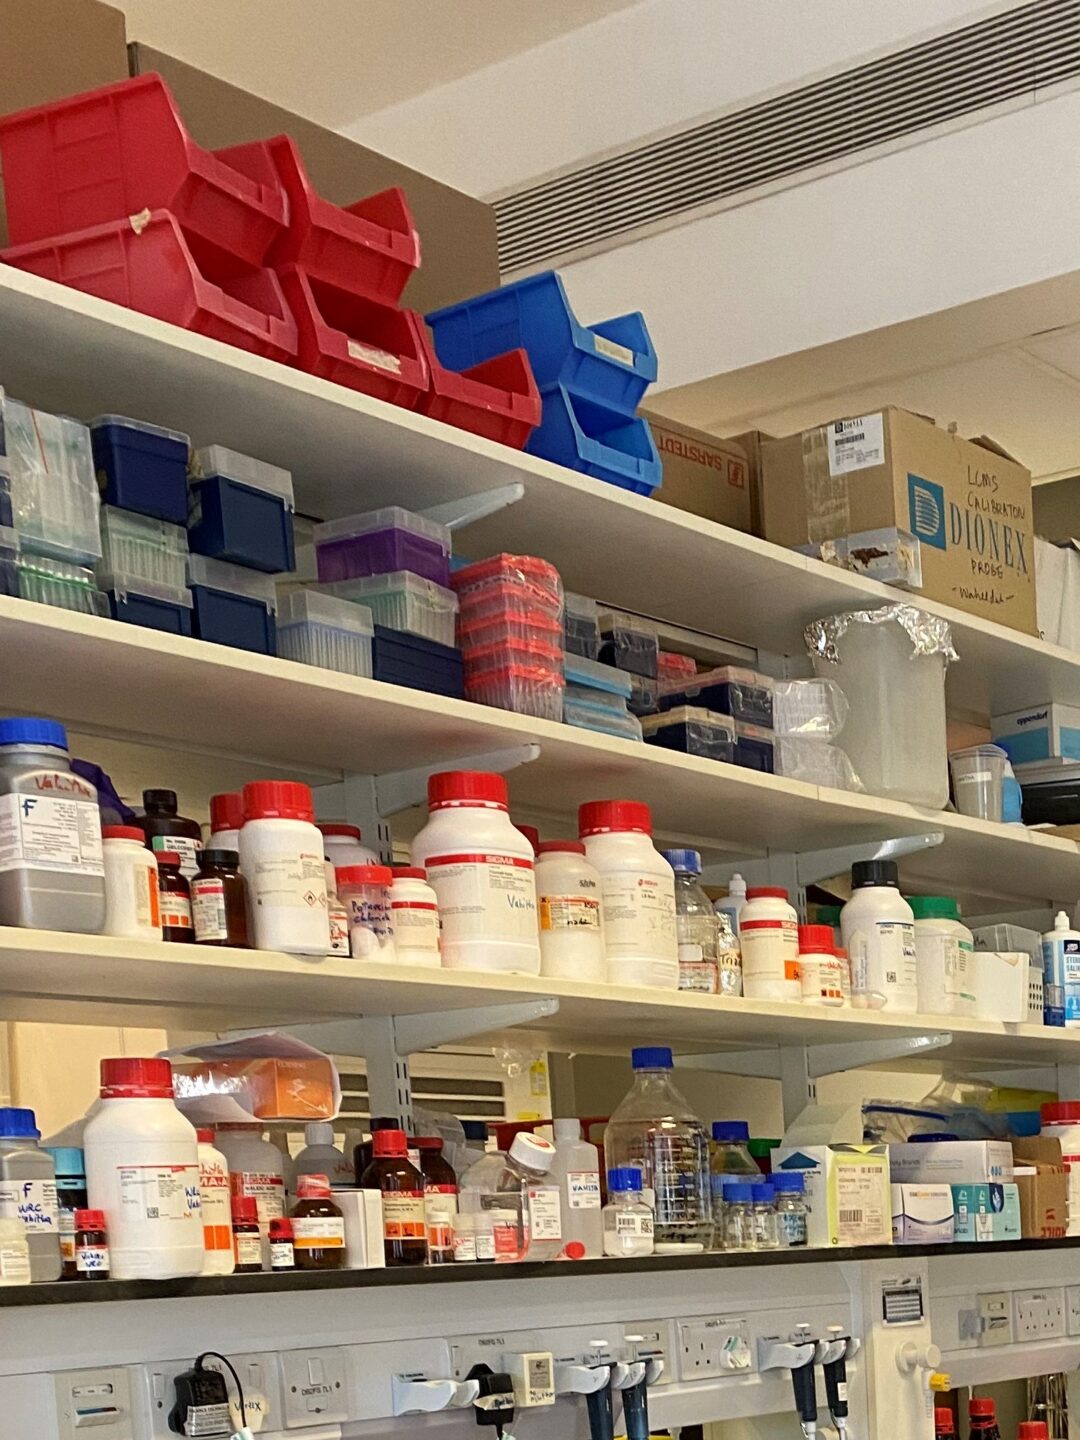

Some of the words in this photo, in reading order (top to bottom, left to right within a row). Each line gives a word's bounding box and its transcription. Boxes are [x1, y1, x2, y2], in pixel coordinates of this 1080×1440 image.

[656, 436, 722, 471] SARSTEDT
[950, 502, 1029, 575] DIONEX
[22, 798, 38, 817] F
[22, 1182, 33, 1198] F
